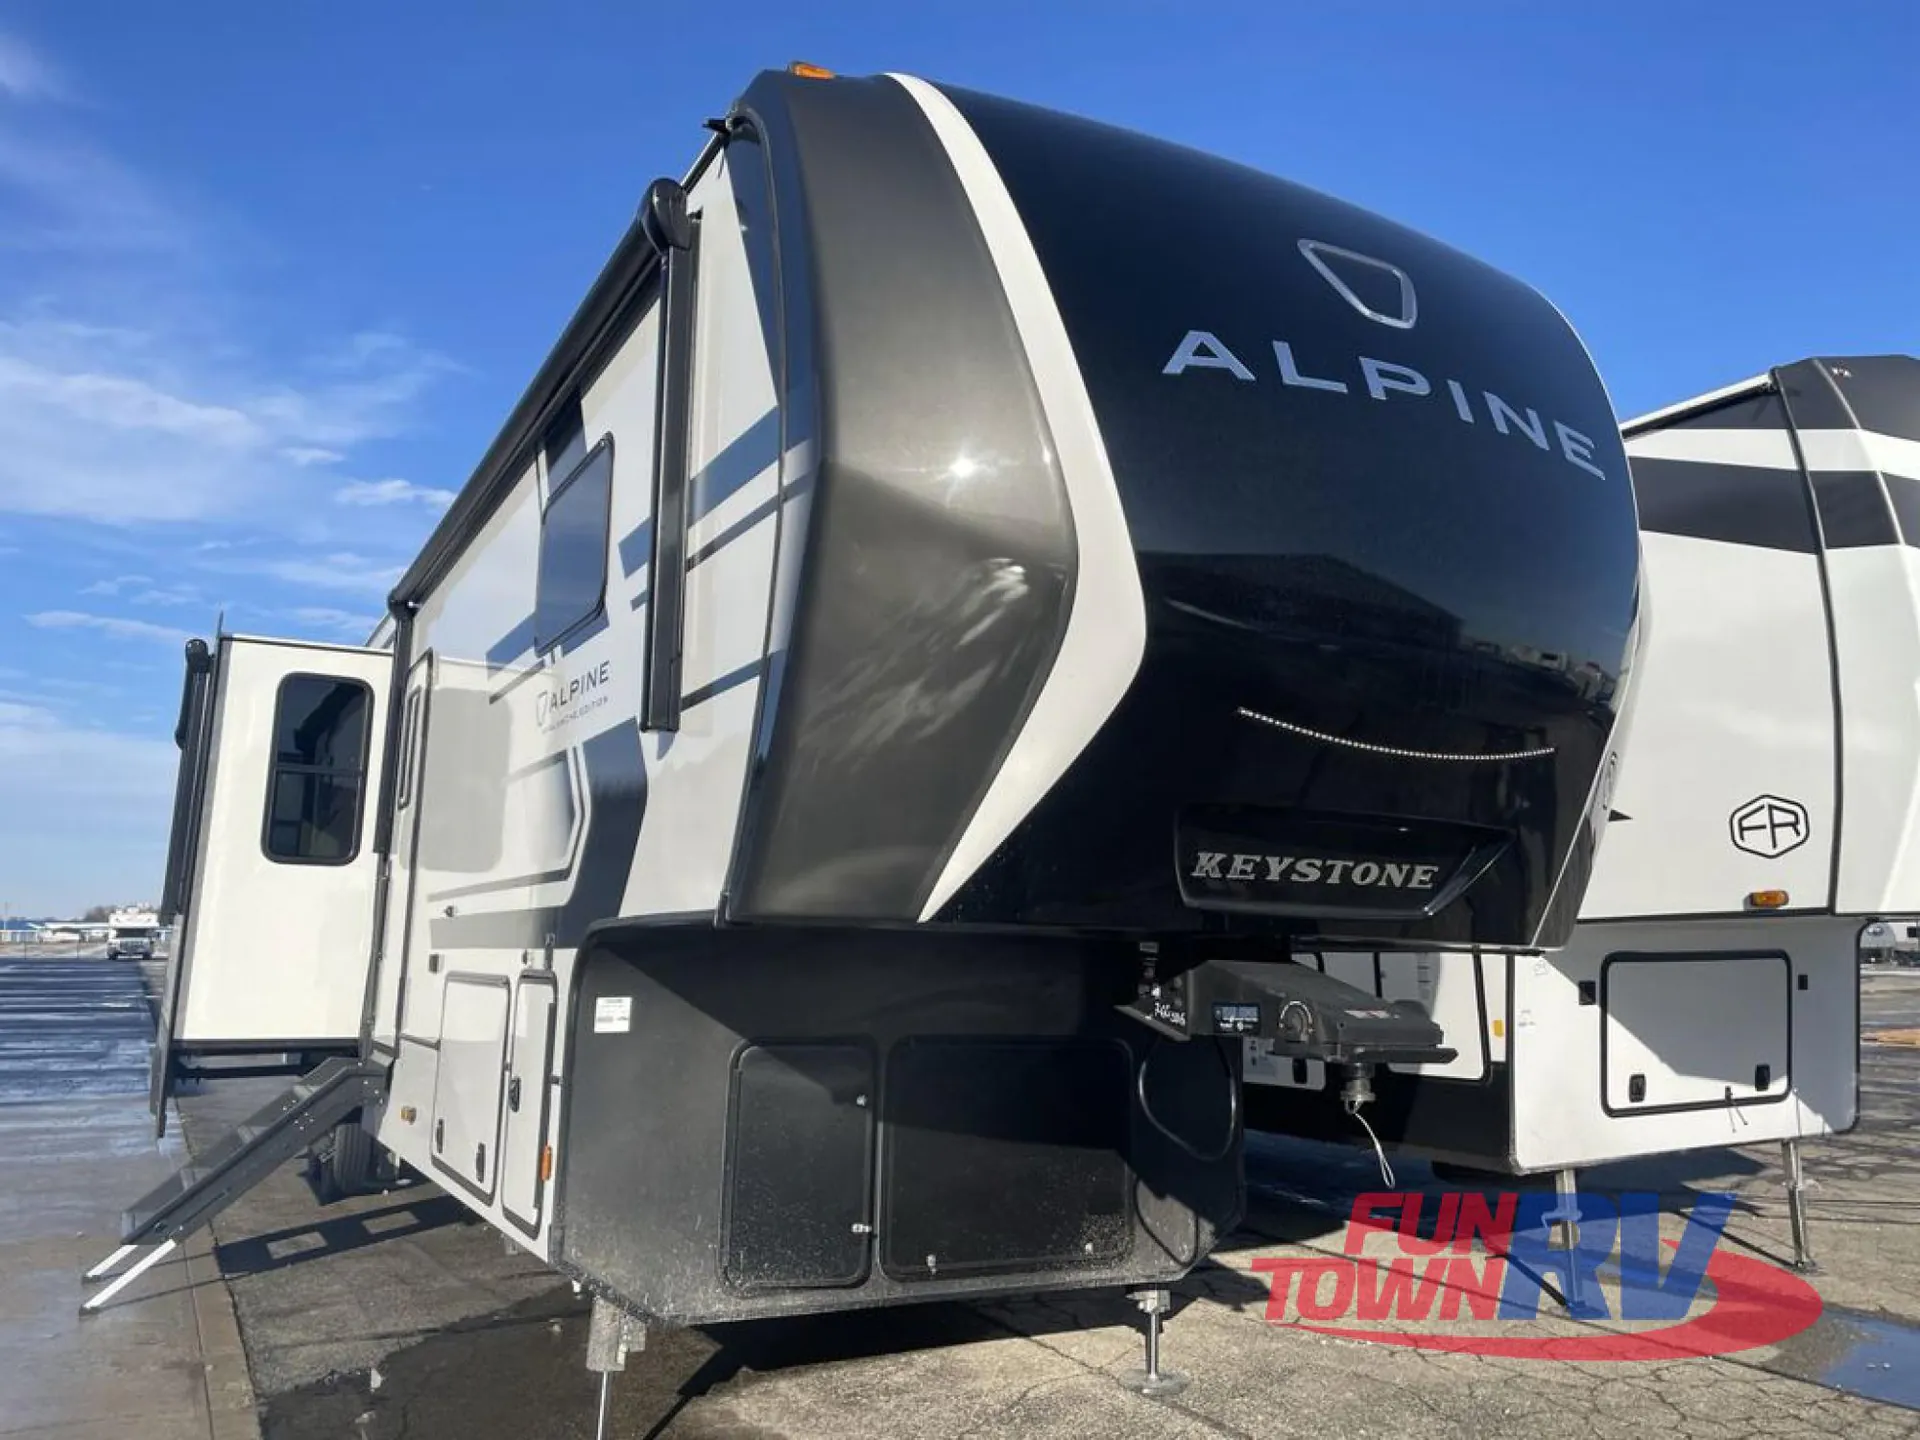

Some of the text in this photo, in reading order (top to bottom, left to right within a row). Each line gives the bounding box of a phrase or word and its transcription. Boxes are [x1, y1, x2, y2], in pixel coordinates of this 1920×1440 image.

[1162, 330, 1606, 481] ALPINE
[549, 660, 610, 712] ALPINE
[1191, 852, 1439, 889] KEYSTONE
